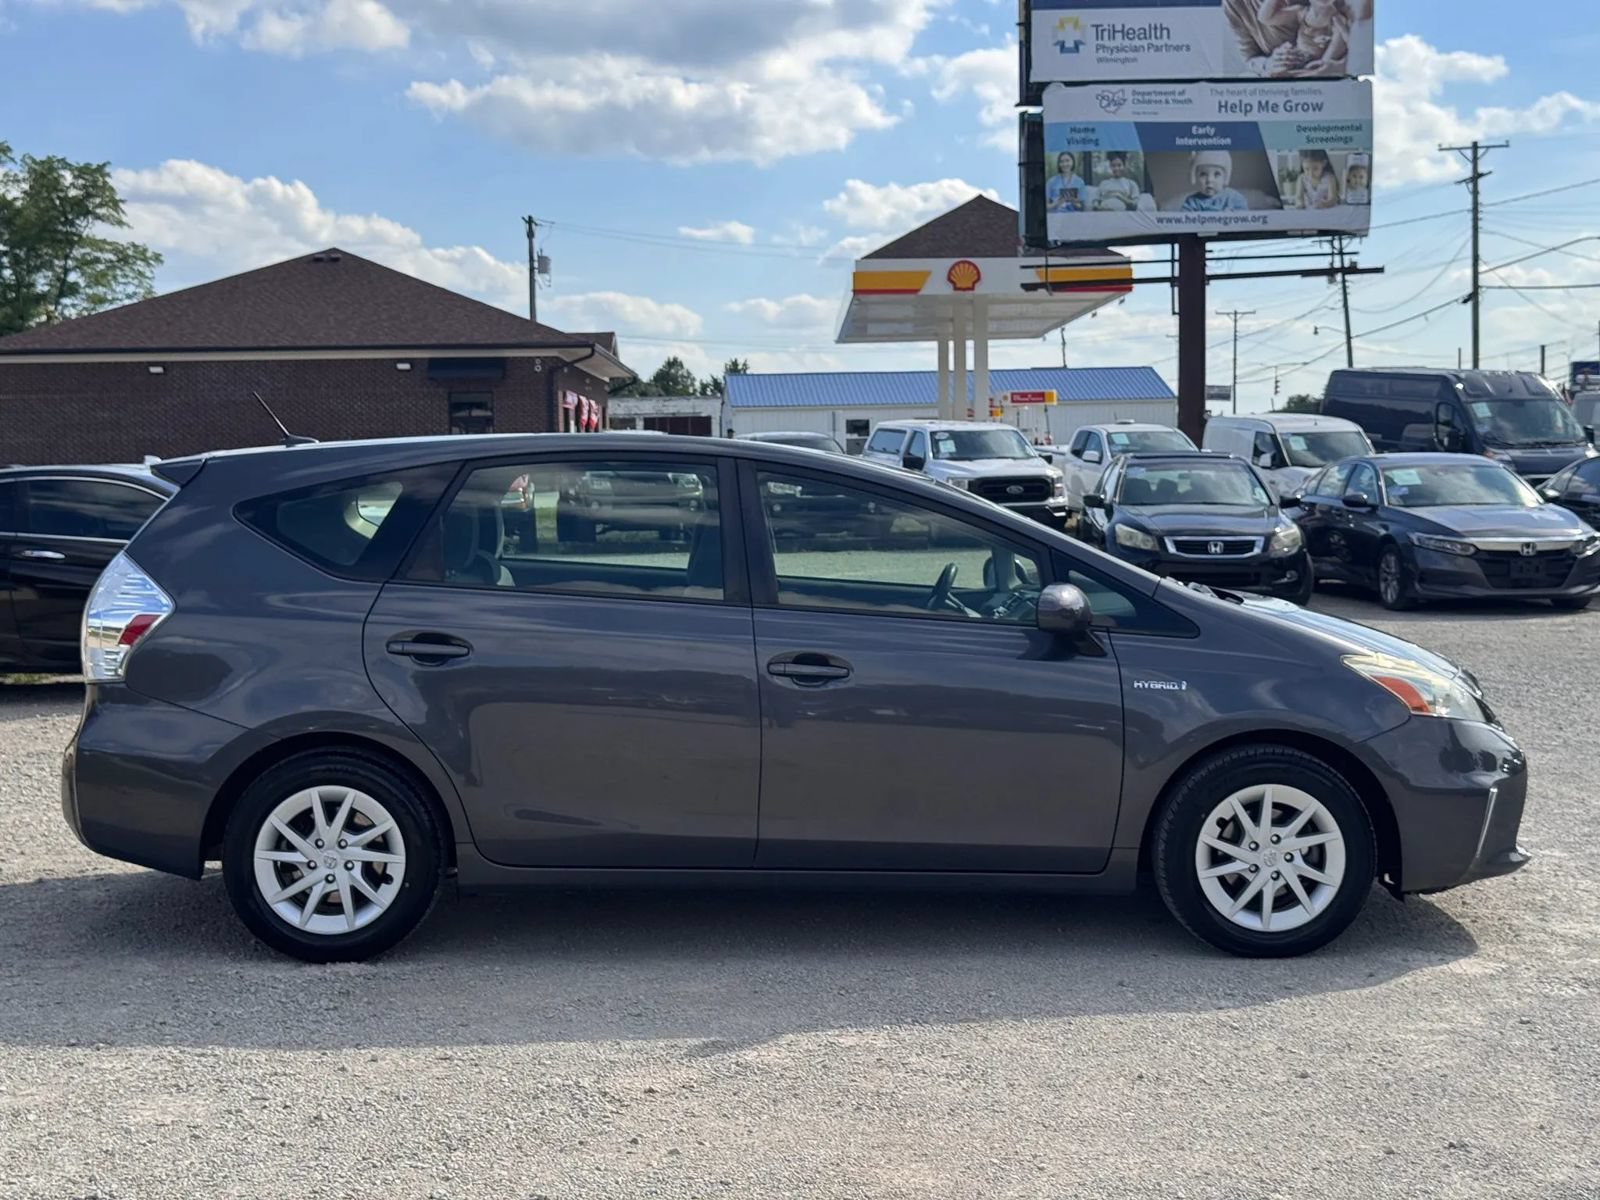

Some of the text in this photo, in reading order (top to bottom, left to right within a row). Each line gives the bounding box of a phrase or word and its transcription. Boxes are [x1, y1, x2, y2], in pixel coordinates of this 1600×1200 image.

[1090, 23, 1171, 41] TriHealth
[1095, 42, 1191, 55] Physician Partners
[1210, 88, 1224, 96] The
[1217, 99, 1324, 117] Help Me Grow
[1191, 125, 1216, 136] Early
[1175, 136, 1232, 146] Intervention
[1155, 213, 1269, 226] www.helpmegrow.org
[1133, 680, 1179, 690] HYBRID
